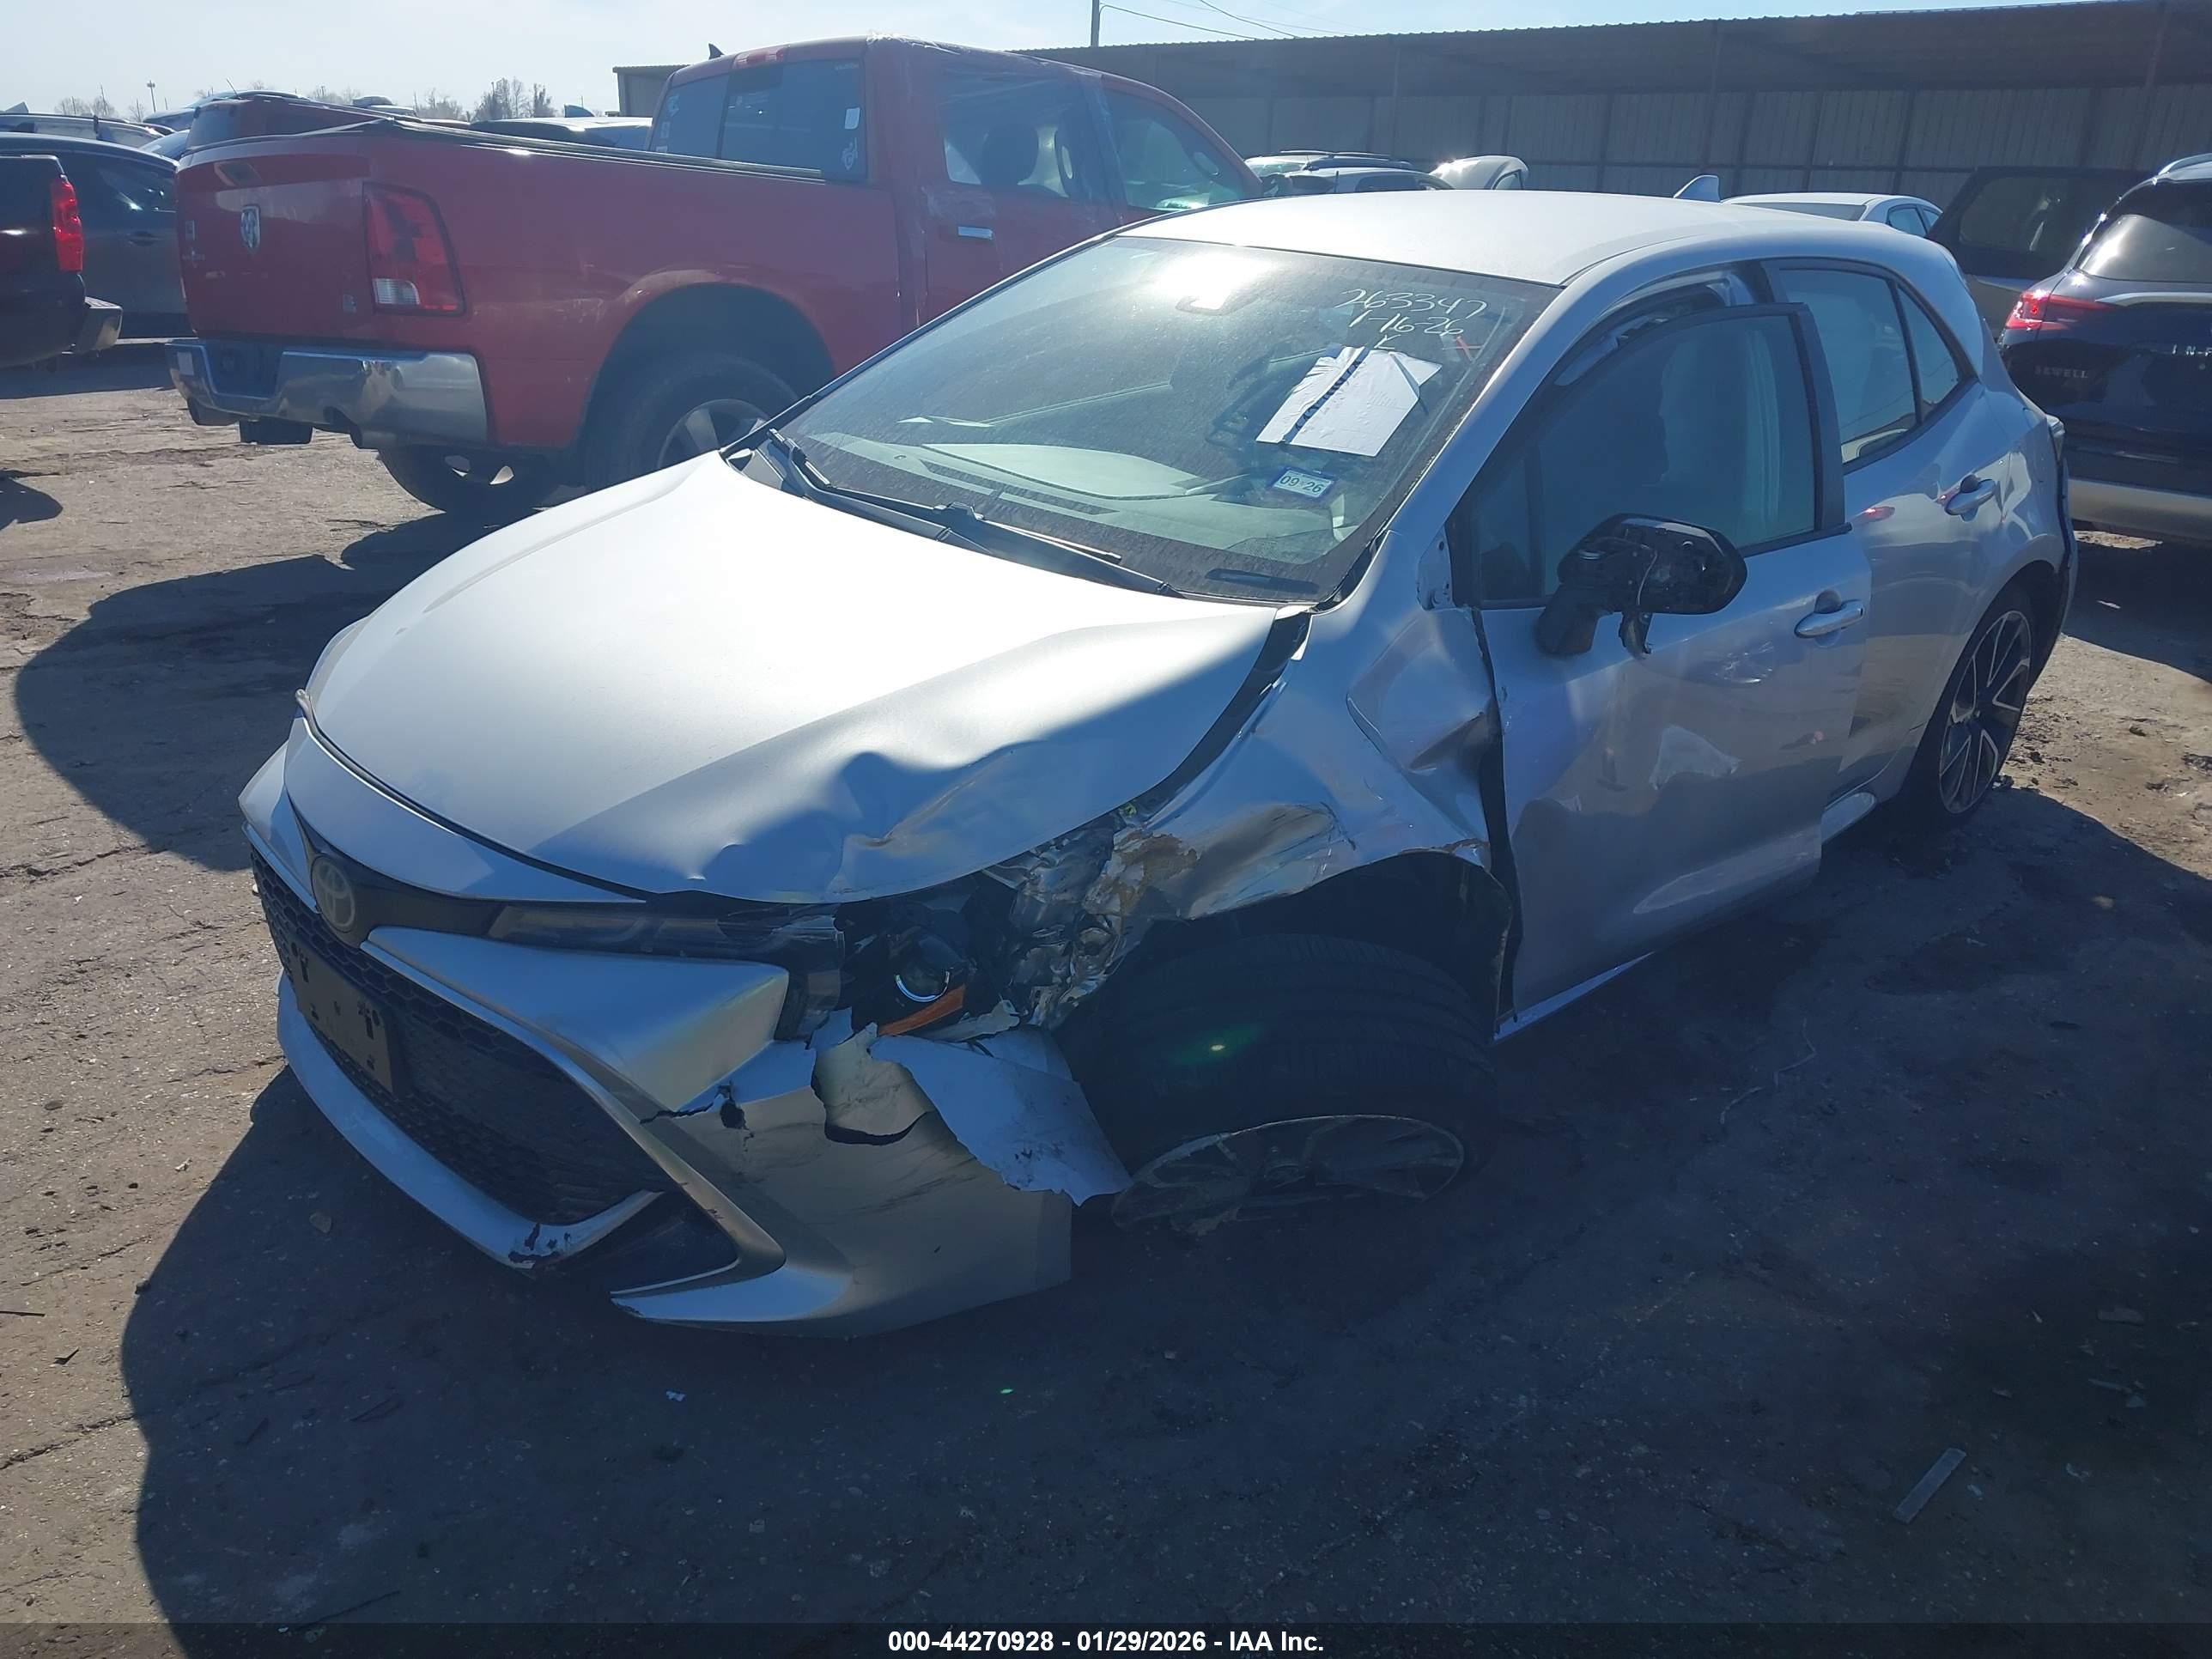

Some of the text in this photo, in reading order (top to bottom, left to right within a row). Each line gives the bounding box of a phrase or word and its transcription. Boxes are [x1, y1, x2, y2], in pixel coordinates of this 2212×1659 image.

[1334, 289, 1487, 319] 263347
[1349, 310, 1465, 337] 1-16-26
[2034, 366, 2088, 378] SEWELL
[1279, 476, 1324, 493] 09 26
